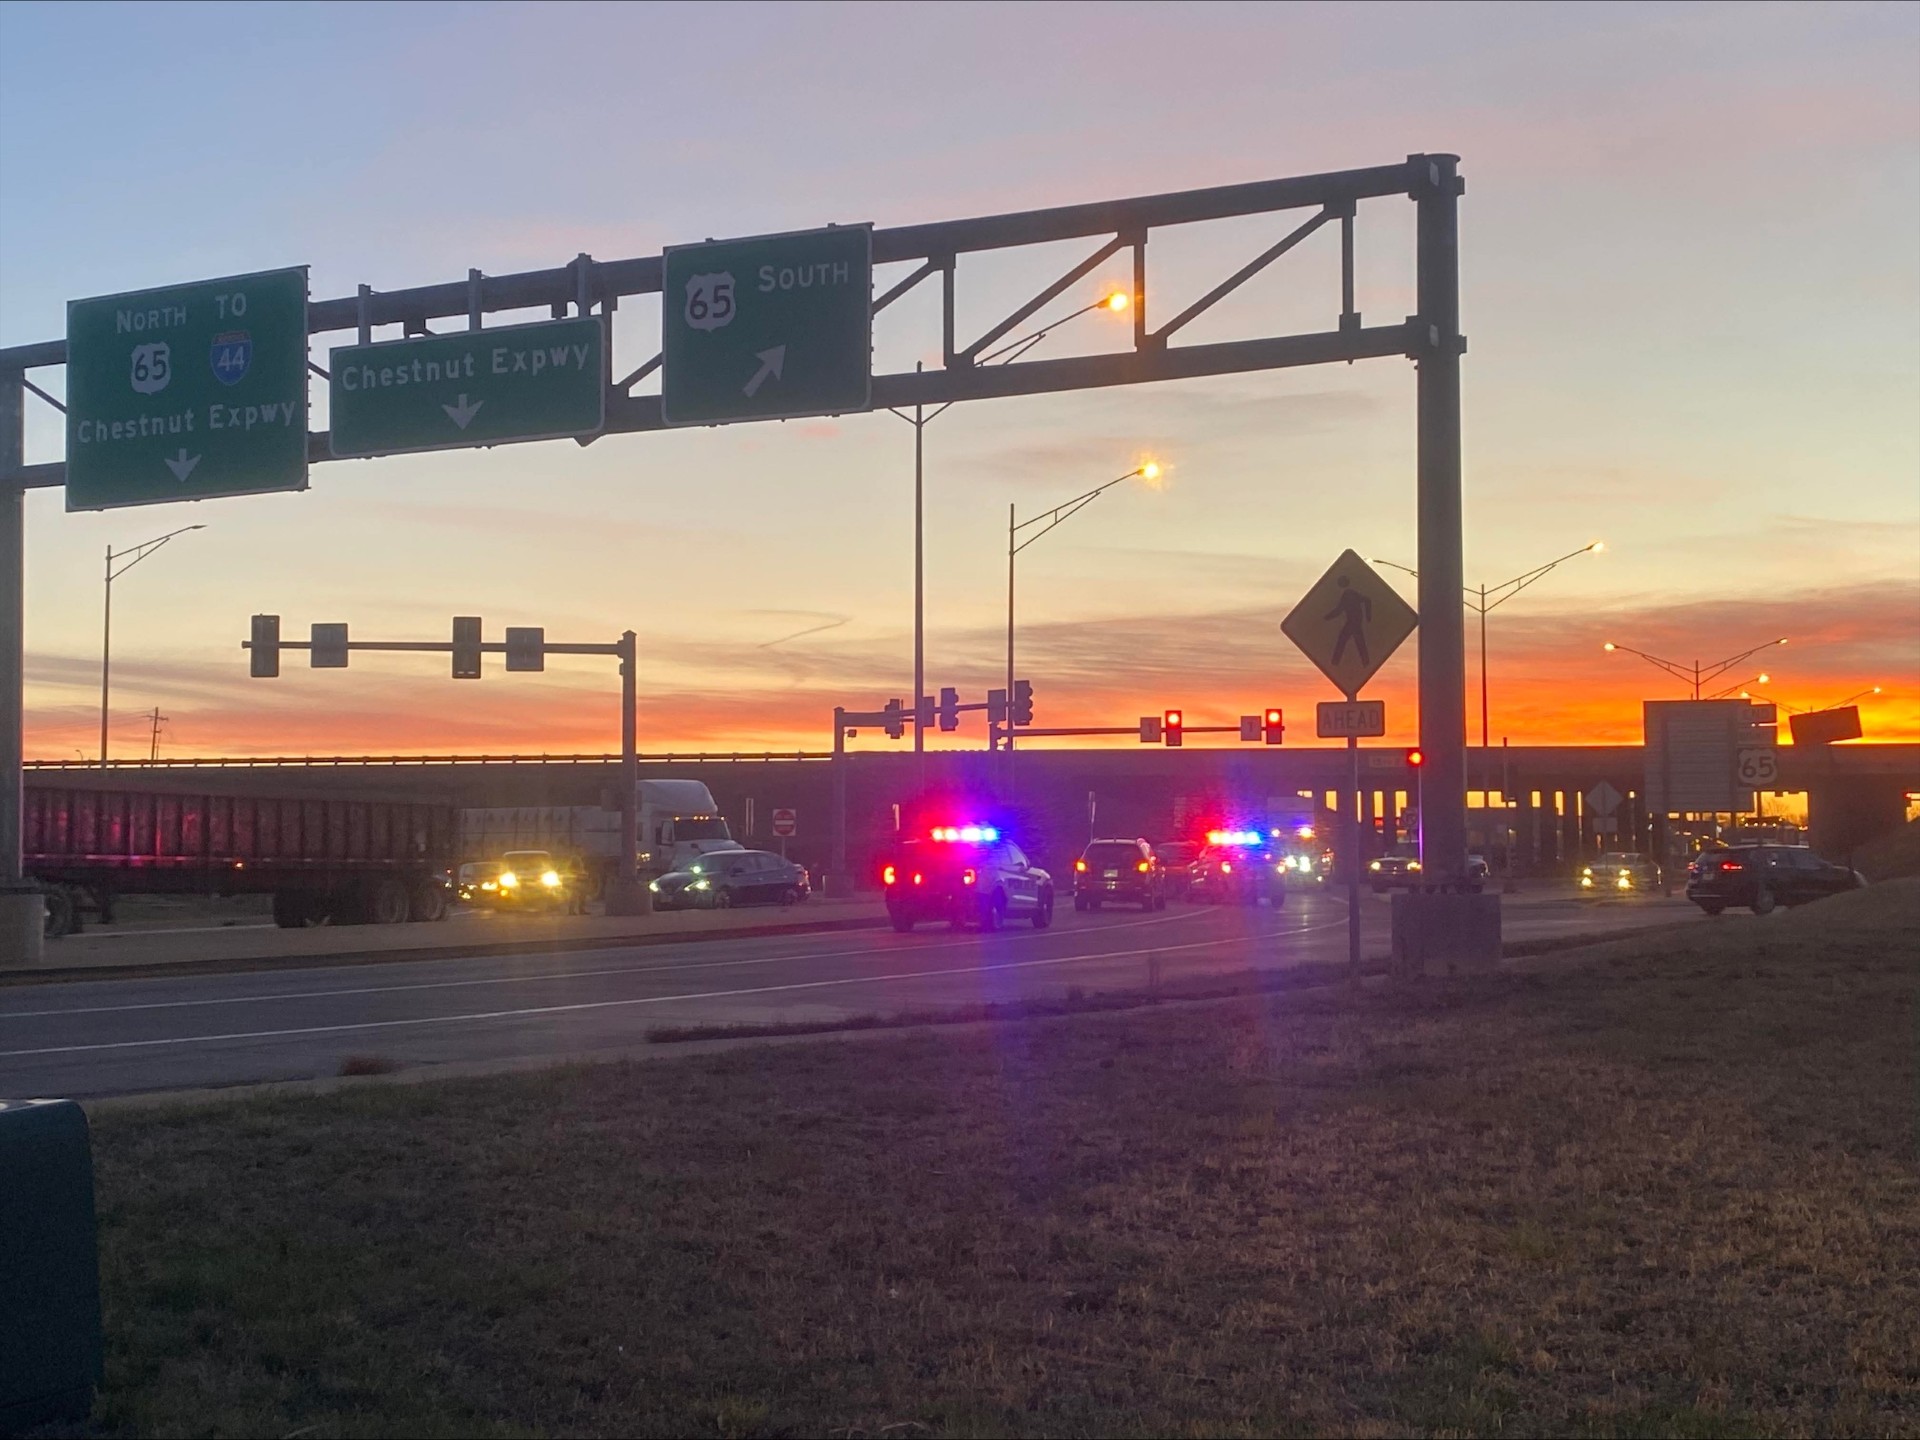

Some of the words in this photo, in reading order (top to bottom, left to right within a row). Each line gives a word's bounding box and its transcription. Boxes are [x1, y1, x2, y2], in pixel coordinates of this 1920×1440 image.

[758, 261, 849, 292] SOUTH
[116, 306, 187, 334] NORTH
[215, 292, 247, 319] TO
[688, 284, 731, 320] 65
[134, 350, 167, 382] 65
[217, 345, 245, 371] 44
[341, 351, 475, 391] Chestnut
[491, 343, 590, 376] Expwy
[78, 408, 195, 444] Chestnut
[209, 401, 297, 431] Expwy
[1322, 709, 1379, 731] AHEAD
[1741, 756, 1775, 779] 65
